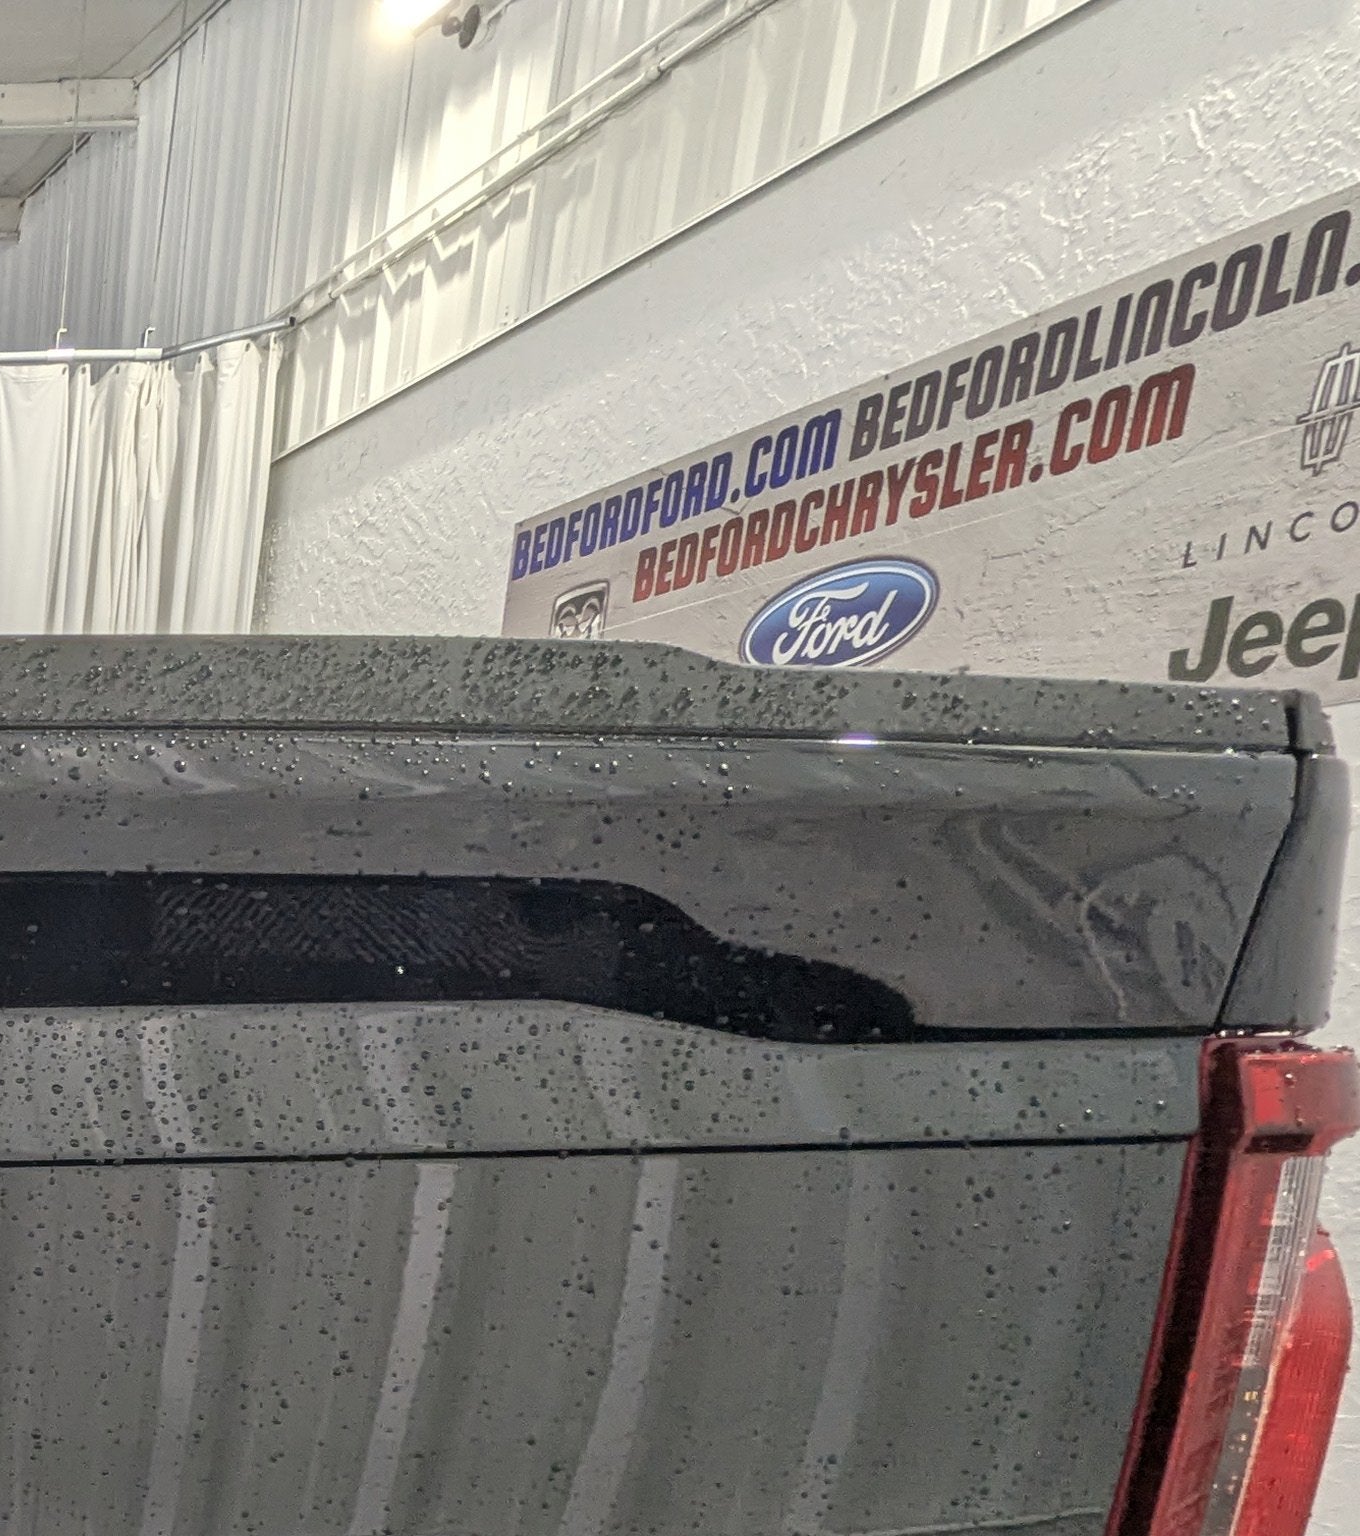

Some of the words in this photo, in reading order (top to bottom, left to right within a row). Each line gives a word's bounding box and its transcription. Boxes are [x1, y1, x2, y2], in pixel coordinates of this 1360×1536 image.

[511, 408, 842, 582] BEDFORDFORD.COM
[632, 362, 1196, 603] BEDFORDCHRYSLER.COM
[1181, 500, 1359, 569] LINCO
[771, 581, 899, 665] Ford
